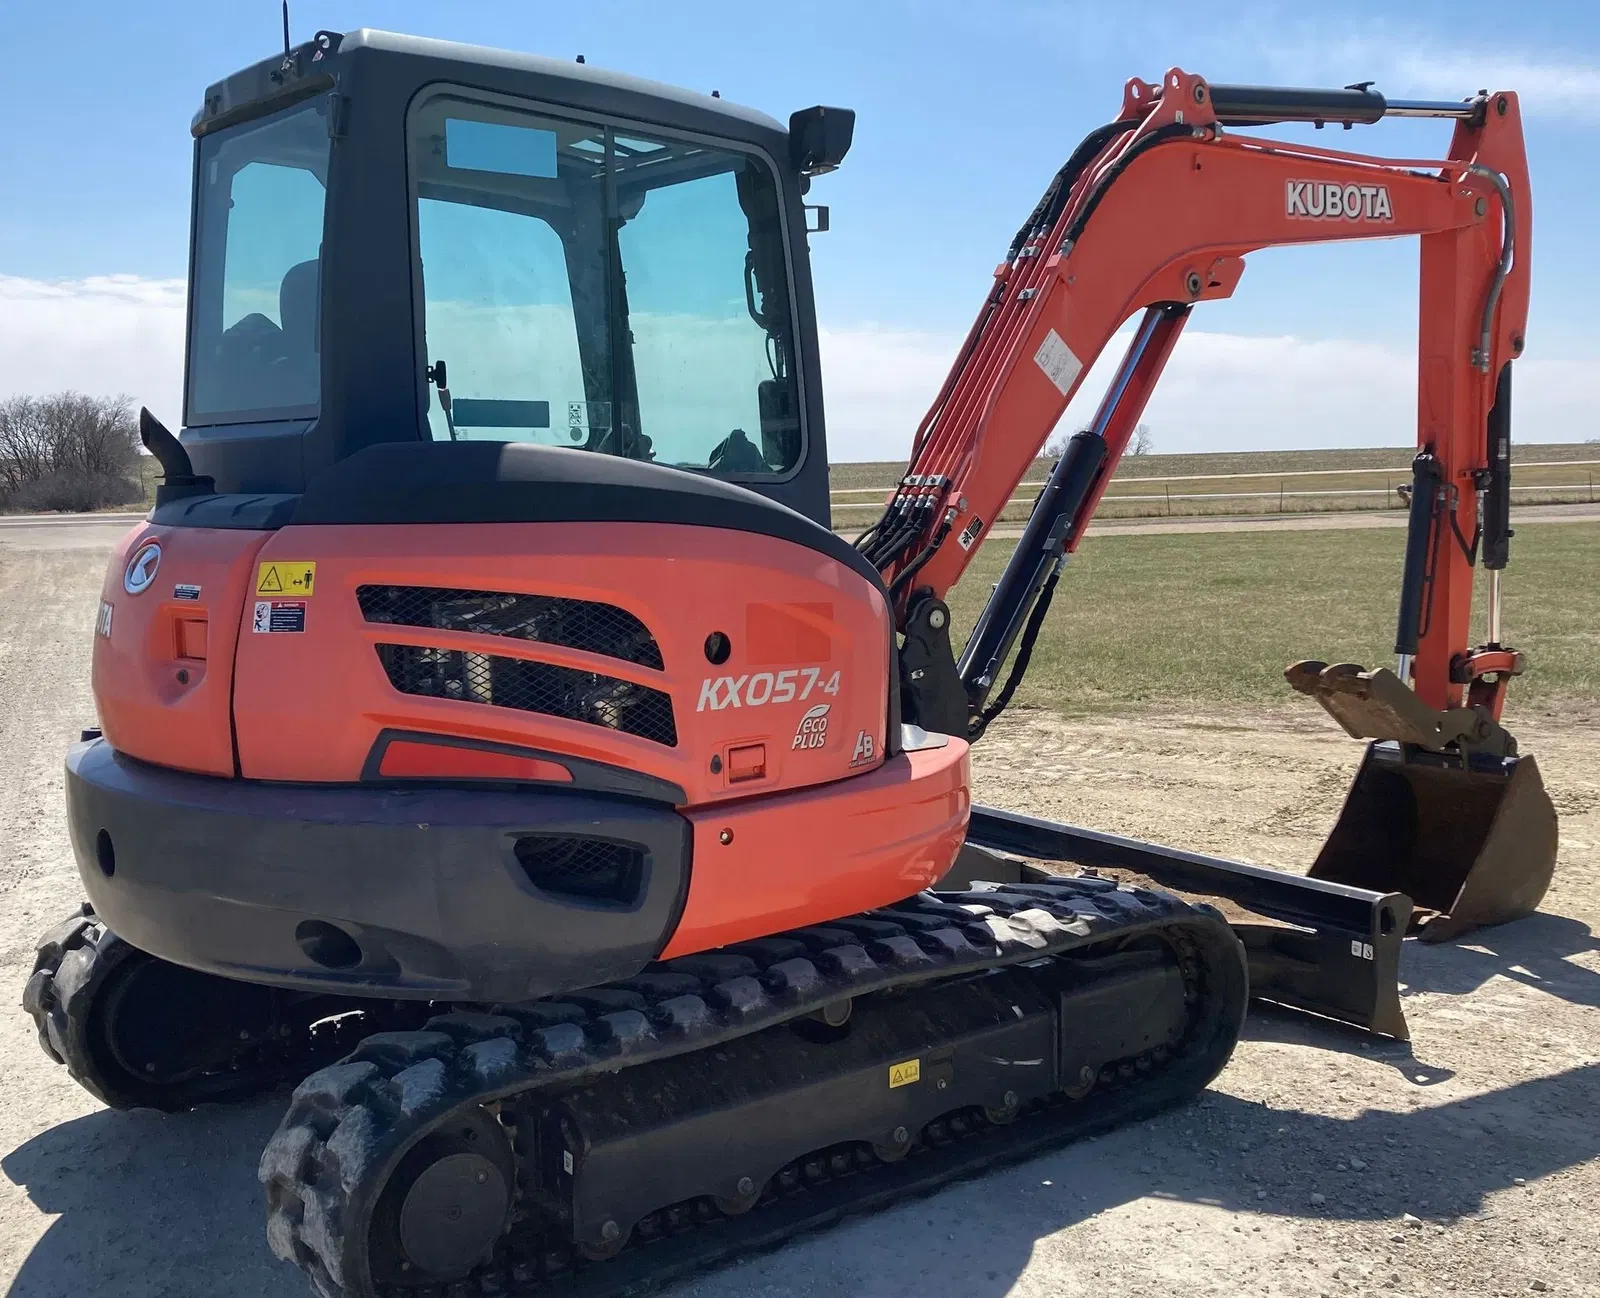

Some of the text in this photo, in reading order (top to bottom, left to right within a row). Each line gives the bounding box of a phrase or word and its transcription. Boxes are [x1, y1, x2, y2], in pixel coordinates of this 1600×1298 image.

[1286, 181, 1393, 220] KUBOTA
[695, 667, 841, 713] KX057-4
[802, 717, 828, 733] eco
[791, 732, 827, 751] PLUS
